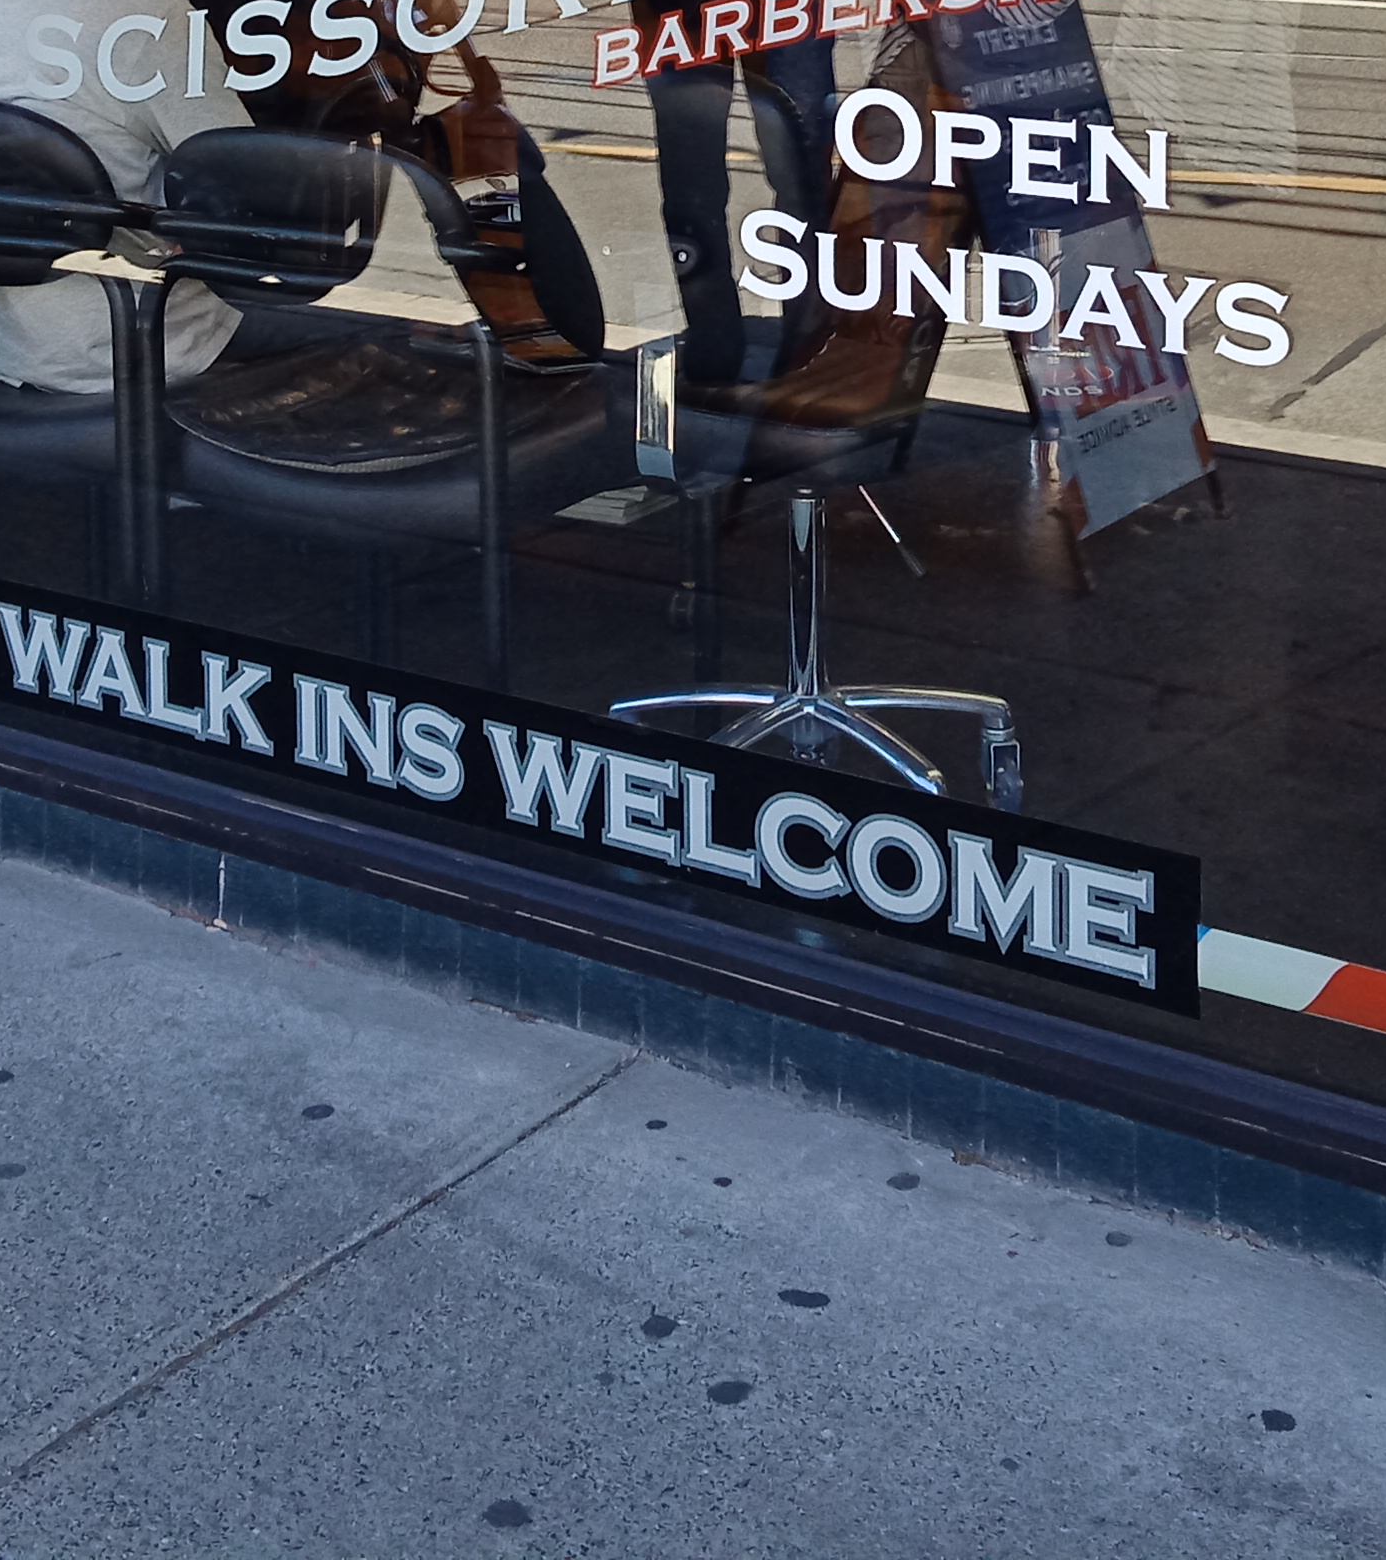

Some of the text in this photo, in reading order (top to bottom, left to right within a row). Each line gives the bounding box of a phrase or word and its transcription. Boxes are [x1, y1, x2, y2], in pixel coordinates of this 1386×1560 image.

[833, 86, 1172, 210] OPEN
[738, 207, 1291, 367] SUNDAYS
[292, 673, 464, 803] INS
[482, 718, 1158, 990] WELCOME
